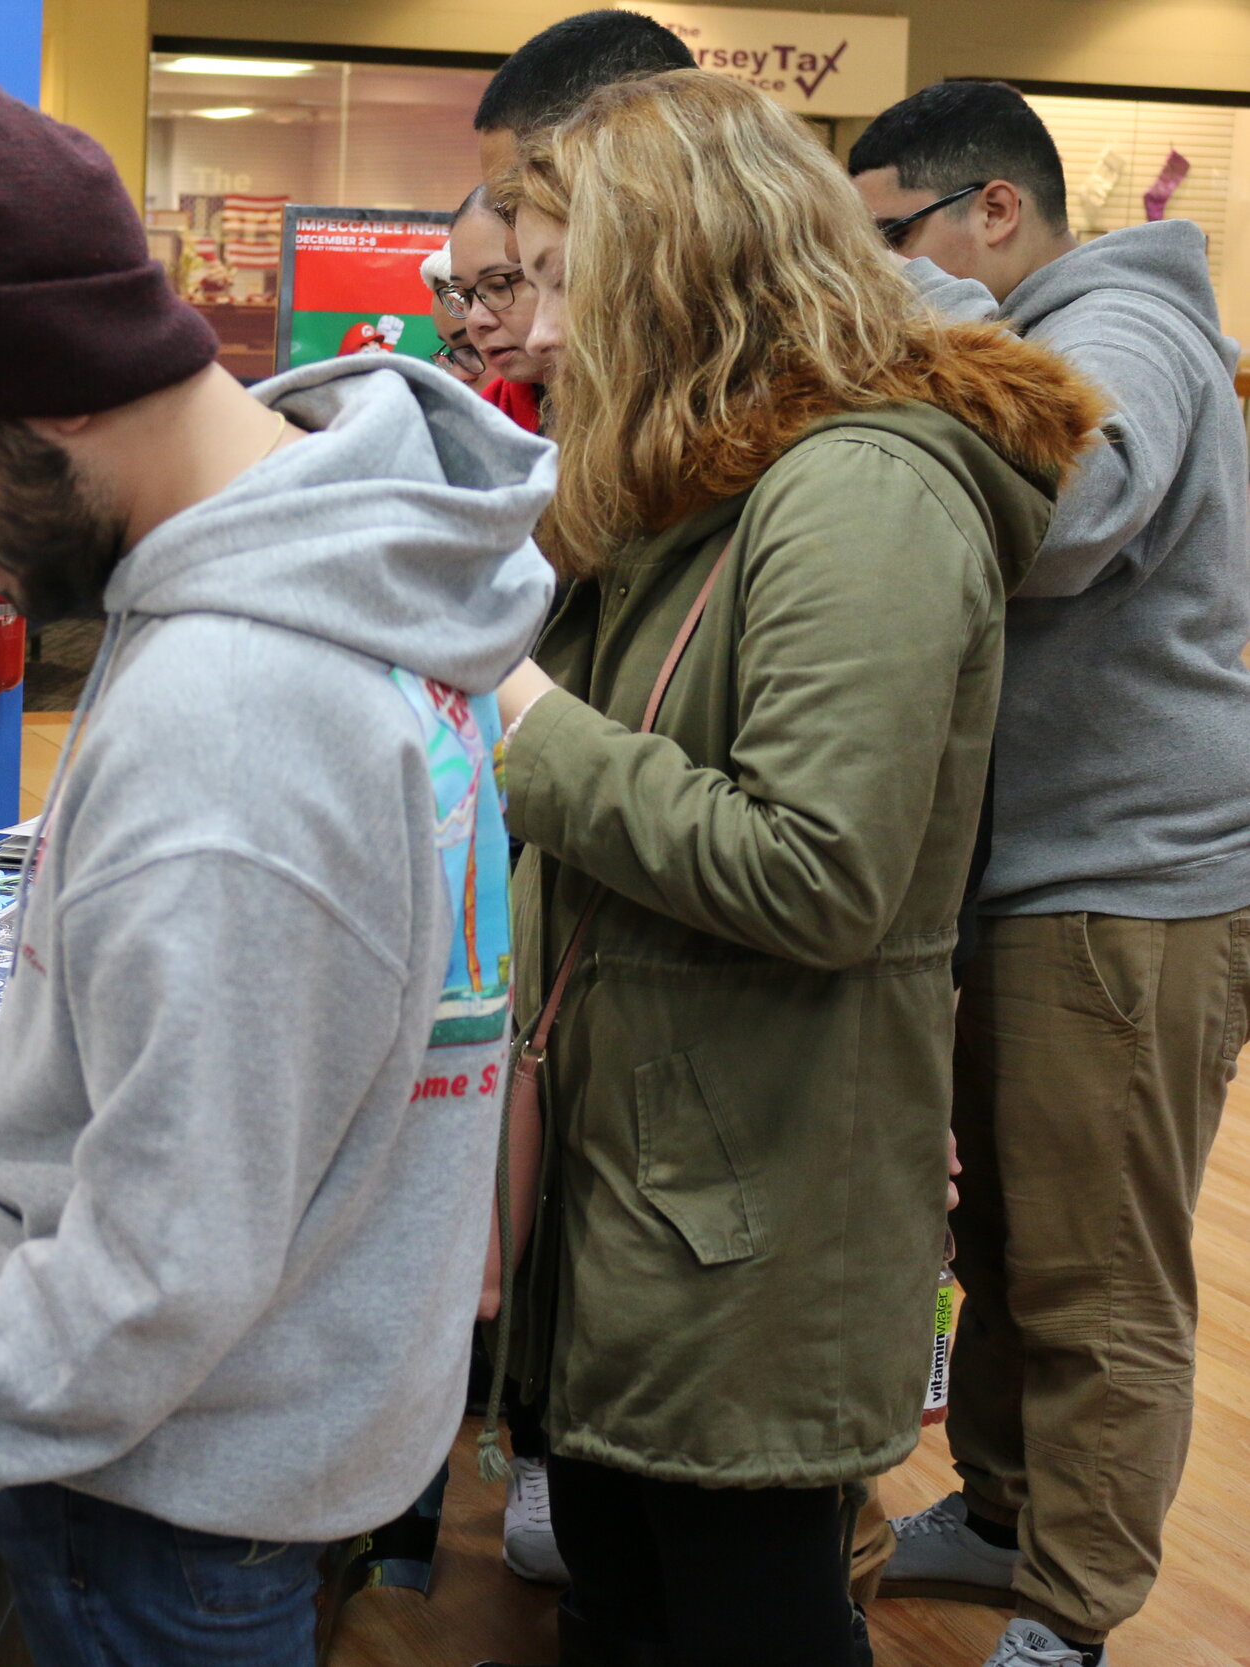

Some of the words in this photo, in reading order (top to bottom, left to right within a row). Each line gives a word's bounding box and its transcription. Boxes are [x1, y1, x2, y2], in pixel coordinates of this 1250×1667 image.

[296, 217, 403, 234] IMPECCABLE
[295, 234, 357, 246] DECEMBER
[1026, 1631, 1049, 1649] NIKE
